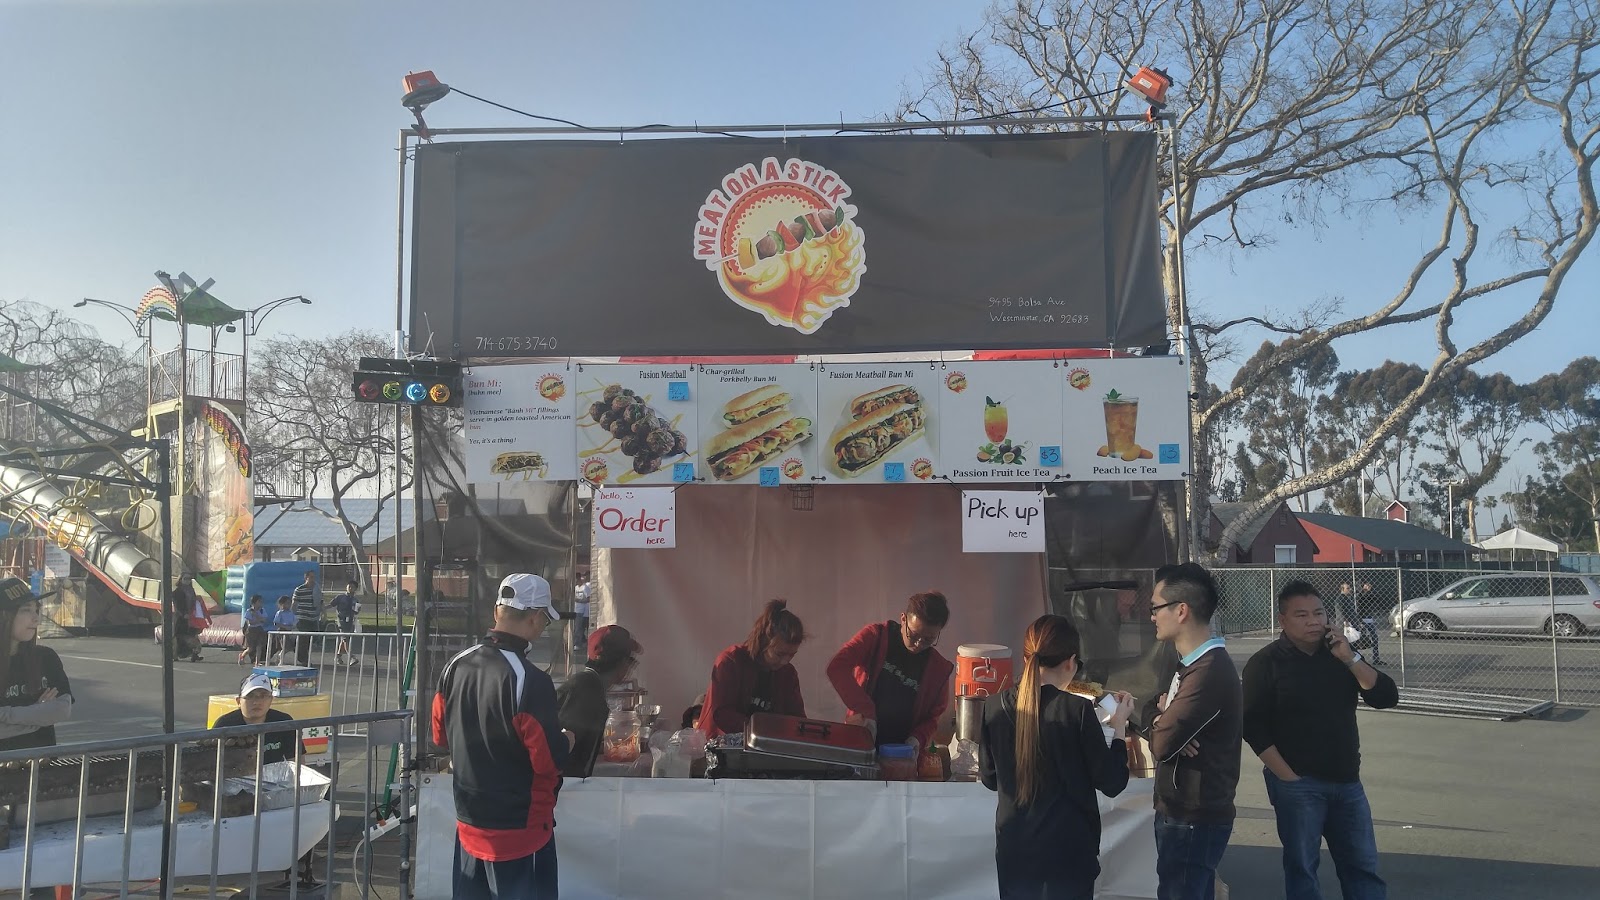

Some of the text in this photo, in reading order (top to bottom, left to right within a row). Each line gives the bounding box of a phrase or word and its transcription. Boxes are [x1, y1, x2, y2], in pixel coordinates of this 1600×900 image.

[698, 162, 846, 255] MEAT ON A STICK
[988, 297, 1066, 307] 9495 Bolsa Ave
[1060, 314, 1089, 324] 92683
[639, 370, 687, 379] Fusion Meatball
[705, 368, 745, 376] Char-grilled
[855, 370, 887, 378] Meatball
[888, 370, 902, 378] Bun
[904, 370, 914, 378] Mi
[1041, 448, 1059, 462] $3
[953, 468, 1050, 477] Passion Fruit Ice Tea
[1093, 465, 1157, 474] Peach Ice Tea
[600, 492, 622, 500] hello,
[968, 497, 1039, 526] Pick up
[599, 508, 670, 532] Order
[1008, 530, 1028, 538] here
[646, 537, 666, 545] here
